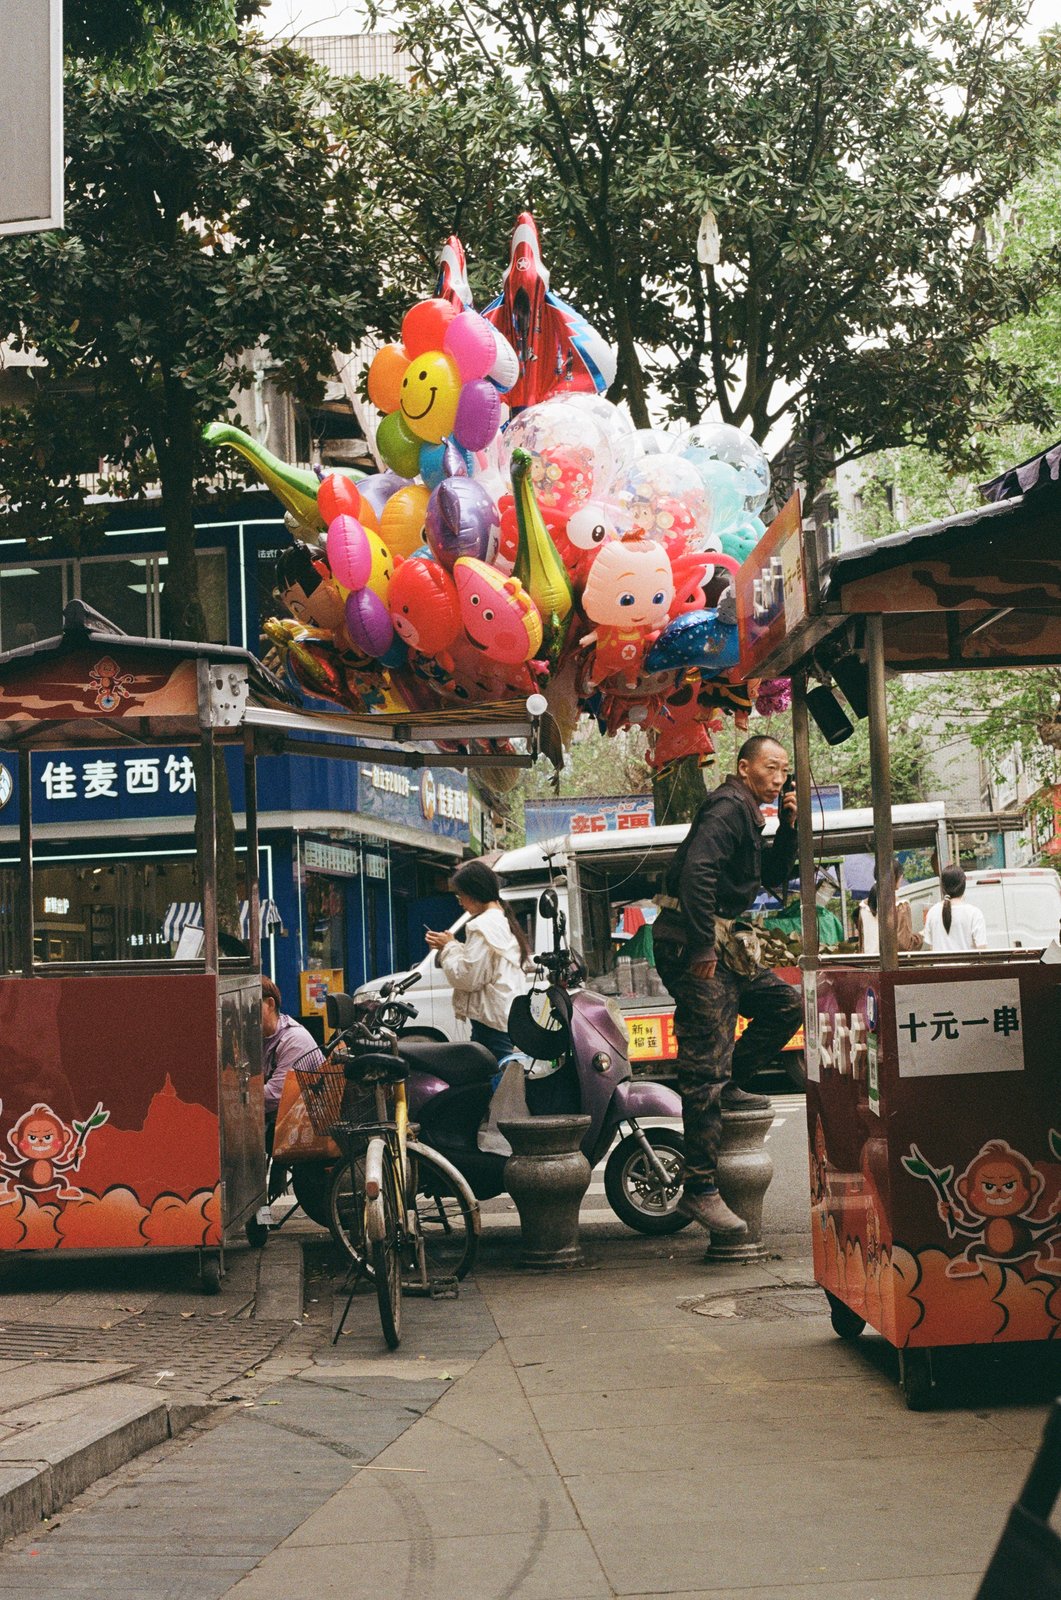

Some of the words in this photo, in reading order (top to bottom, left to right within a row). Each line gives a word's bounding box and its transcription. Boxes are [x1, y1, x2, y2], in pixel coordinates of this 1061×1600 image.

[41, 754, 196, 800] 佳麦西饼
[899, 1005, 1020, 1043] 十元一串
